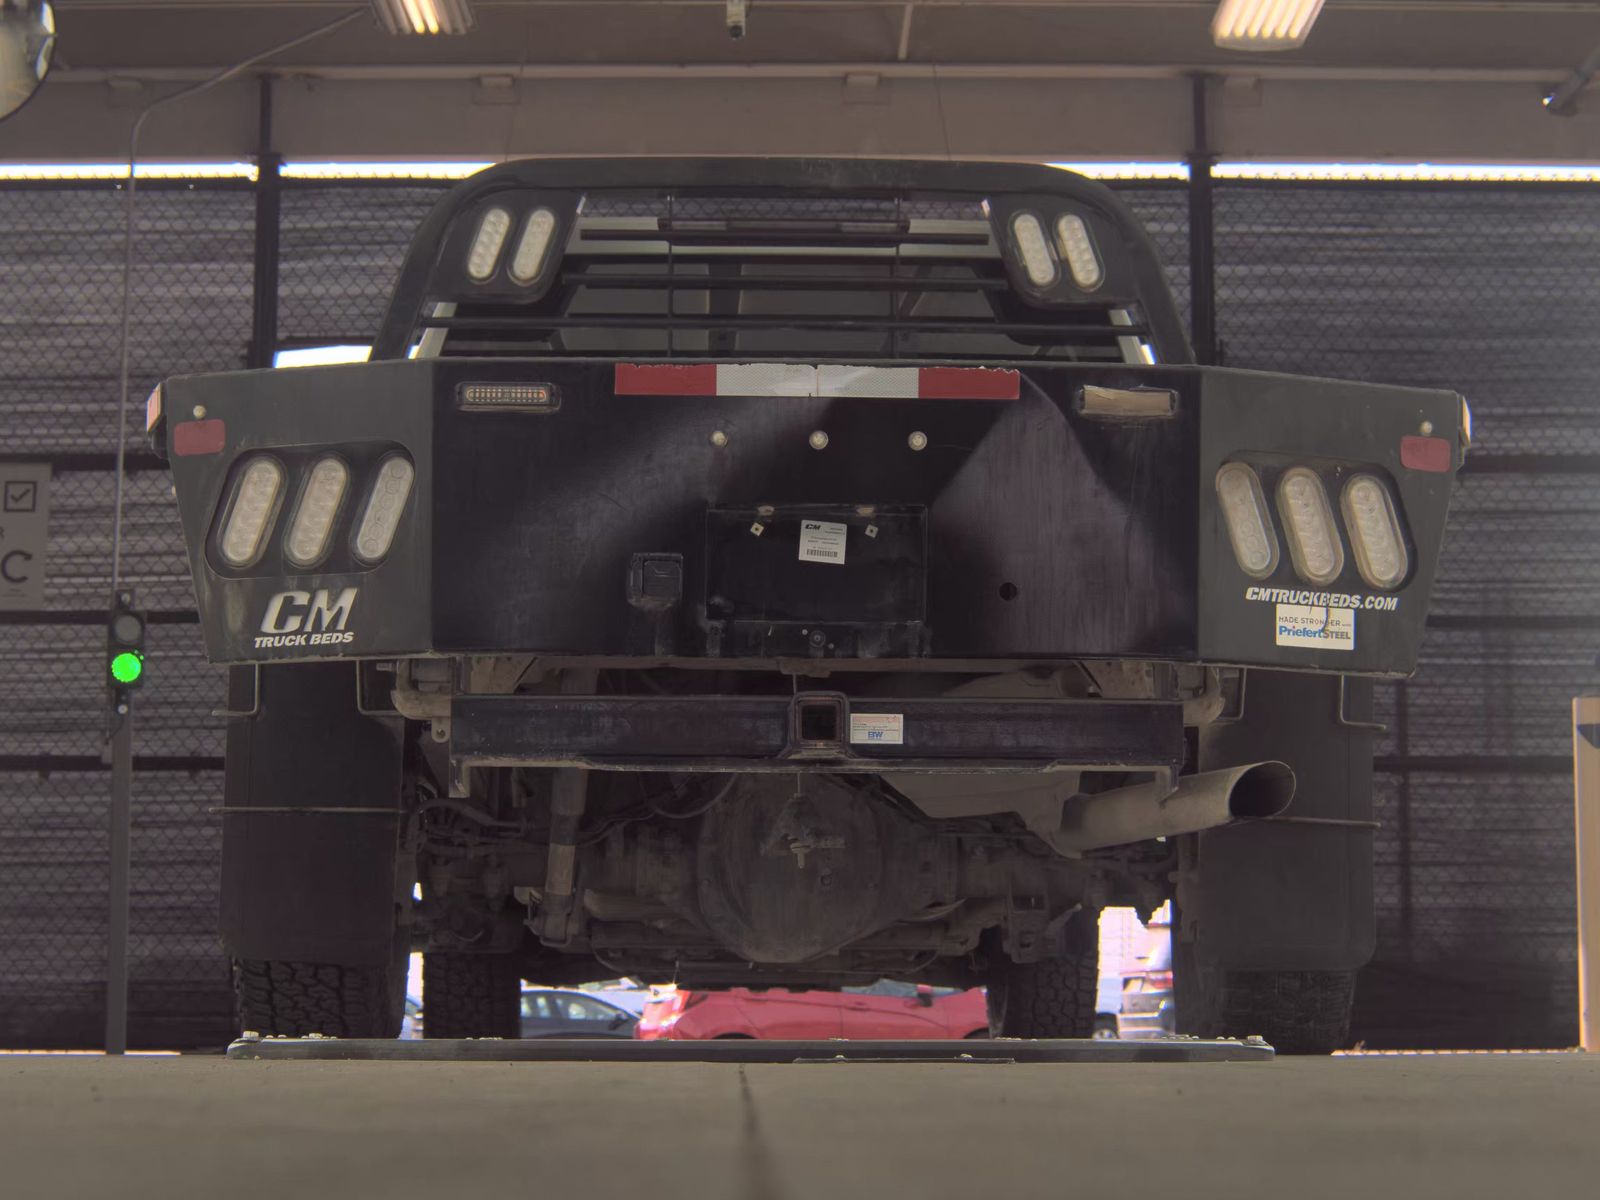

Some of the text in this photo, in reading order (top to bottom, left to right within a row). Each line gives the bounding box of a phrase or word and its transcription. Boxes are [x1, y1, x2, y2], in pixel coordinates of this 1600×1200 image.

[1246, 587, 1398, 611] CMTRUCKBEDS.COM
[261, 588, 358, 633] CM
[1278, 616, 1299, 624] MADE
[1300, 618, 1341, 626] STRONER
[254, 632, 354, 648] TRUCK BEDS
